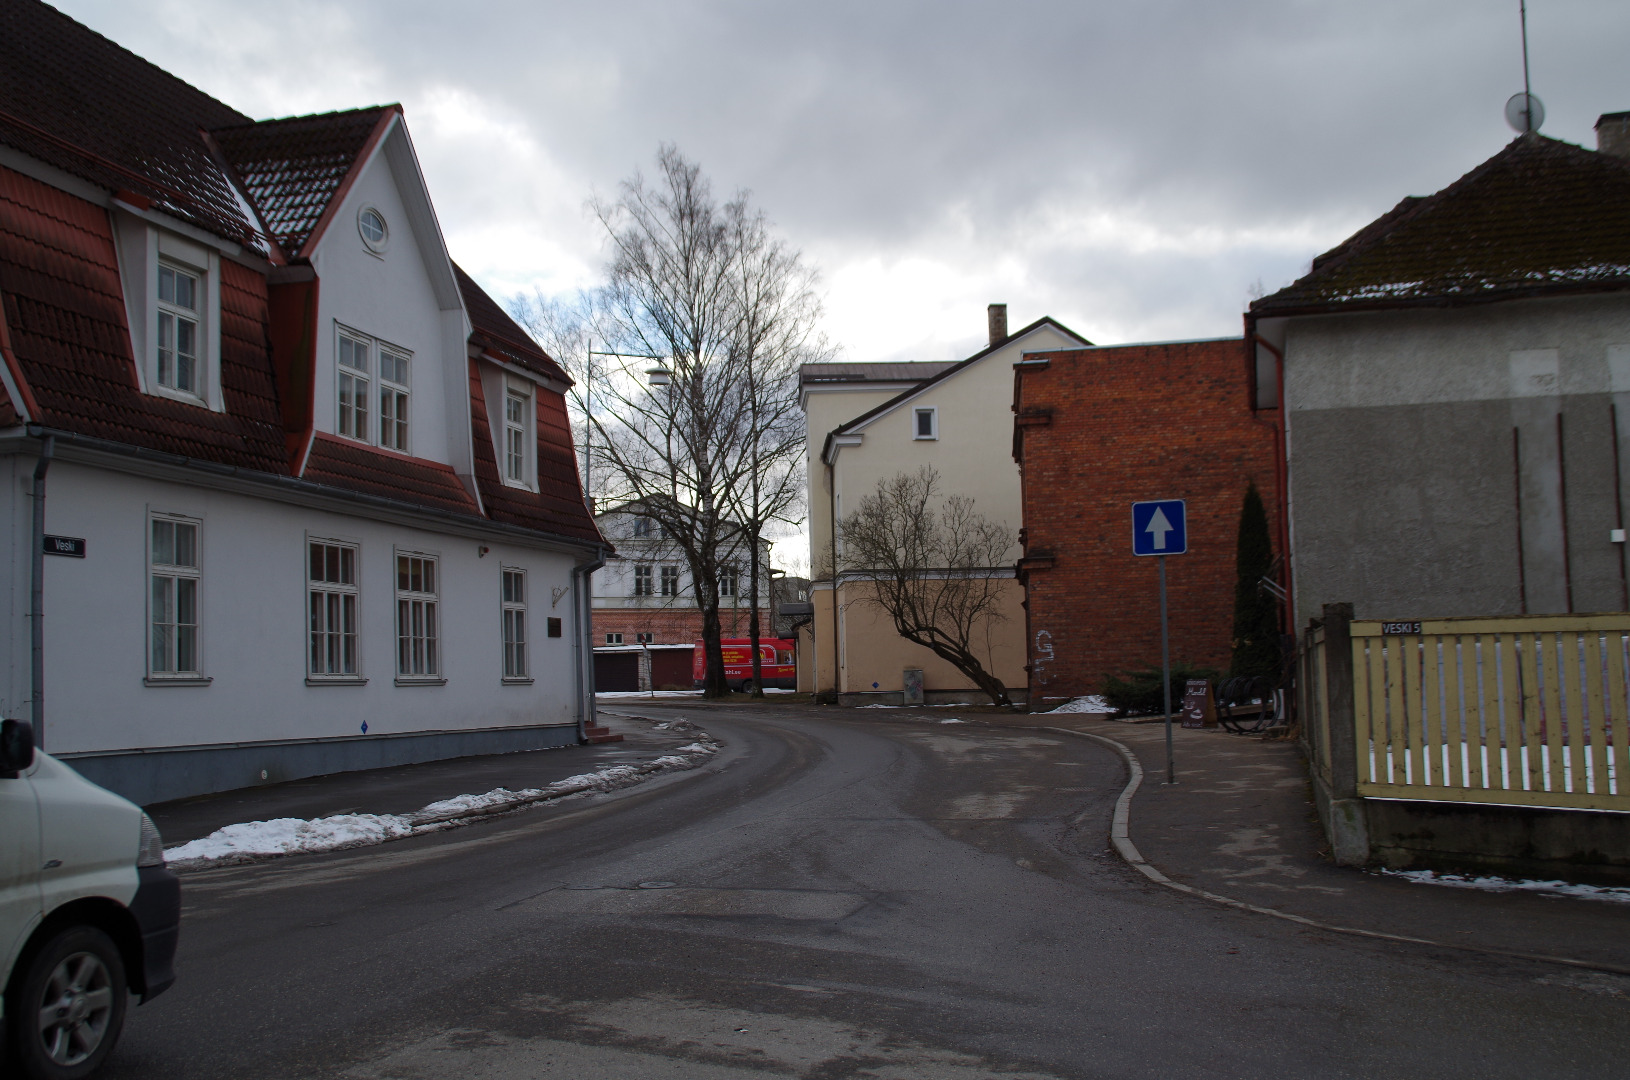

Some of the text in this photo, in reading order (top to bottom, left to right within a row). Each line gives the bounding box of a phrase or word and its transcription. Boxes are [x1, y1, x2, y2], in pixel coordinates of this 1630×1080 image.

[55, 538, 75, 551] Veski
[1382, 623, 1421, 634] VESKI 5
